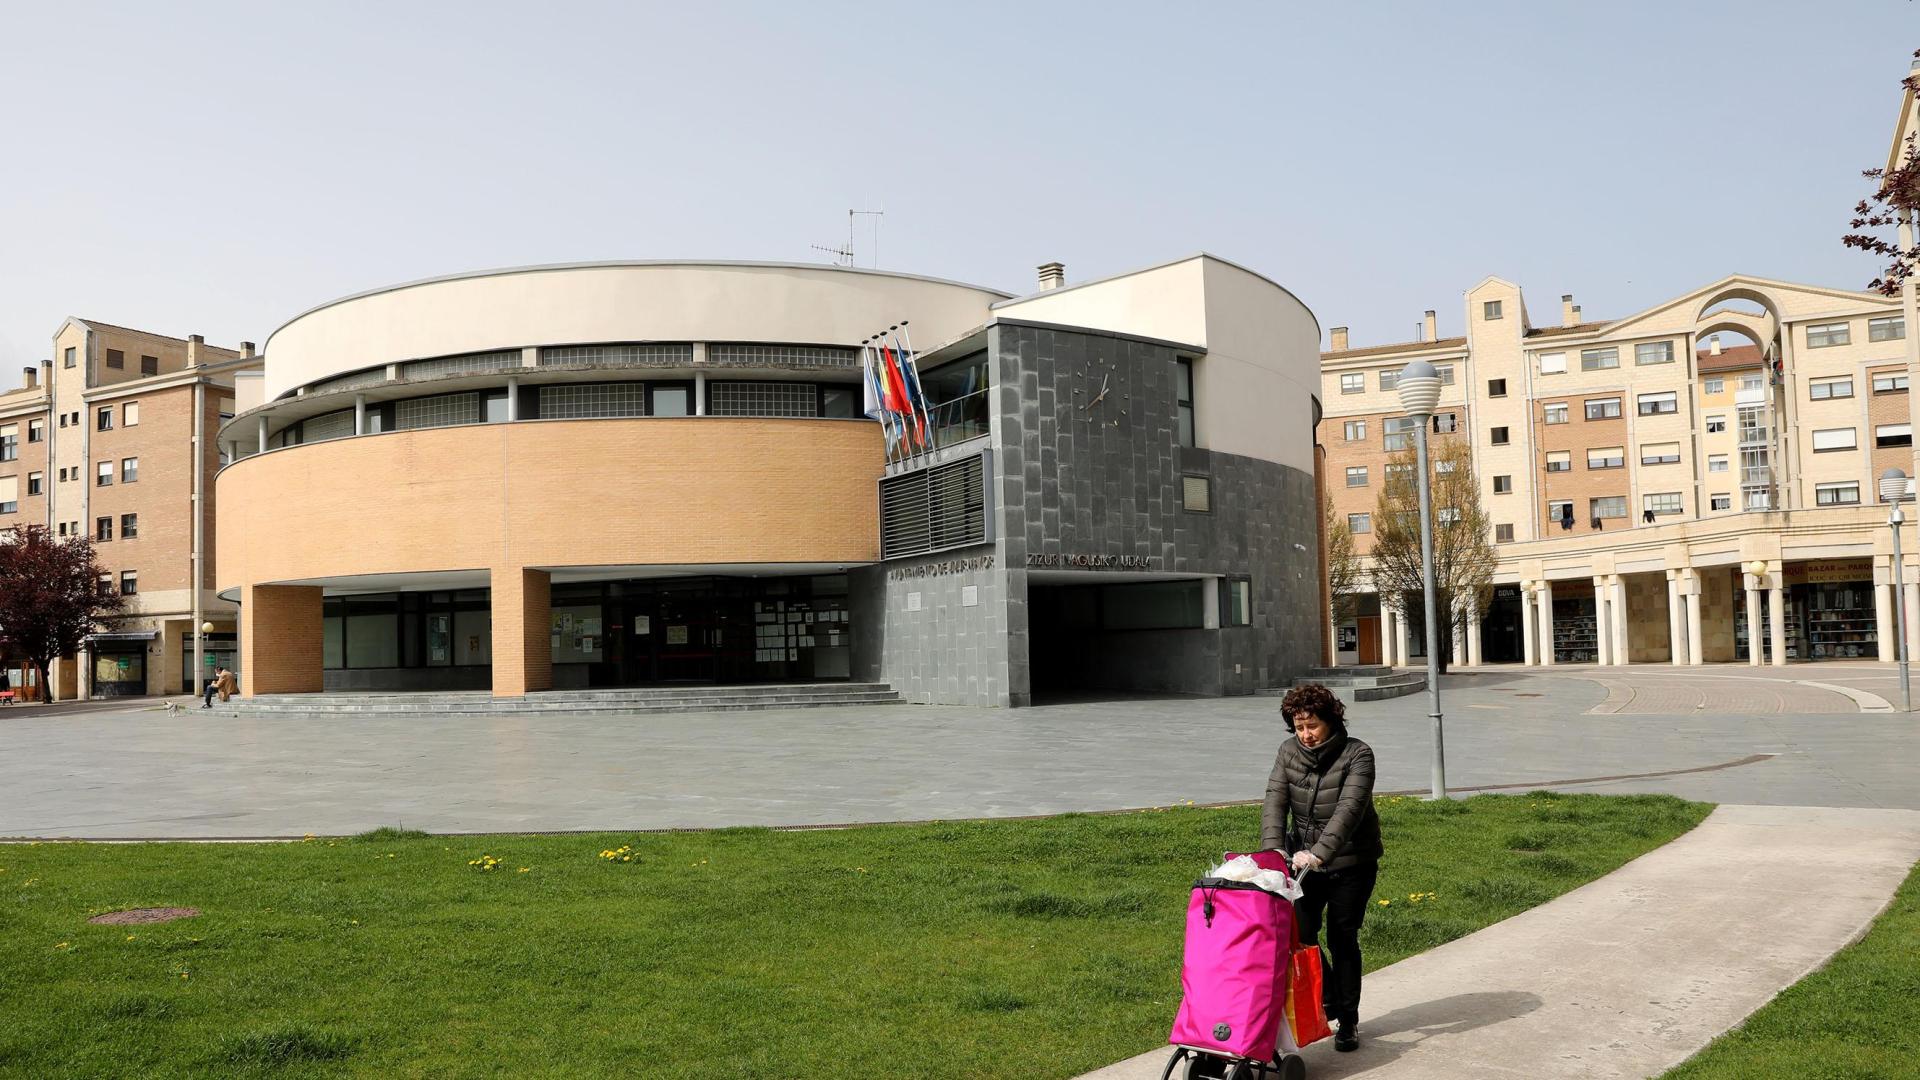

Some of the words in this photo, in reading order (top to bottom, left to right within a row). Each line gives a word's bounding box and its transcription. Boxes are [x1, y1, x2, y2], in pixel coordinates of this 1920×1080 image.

[1027, 554, 1058, 565] ZIZUR
[1121, 555, 1150, 567] UDALA
[1498, 589, 1515, 597] BBVA
